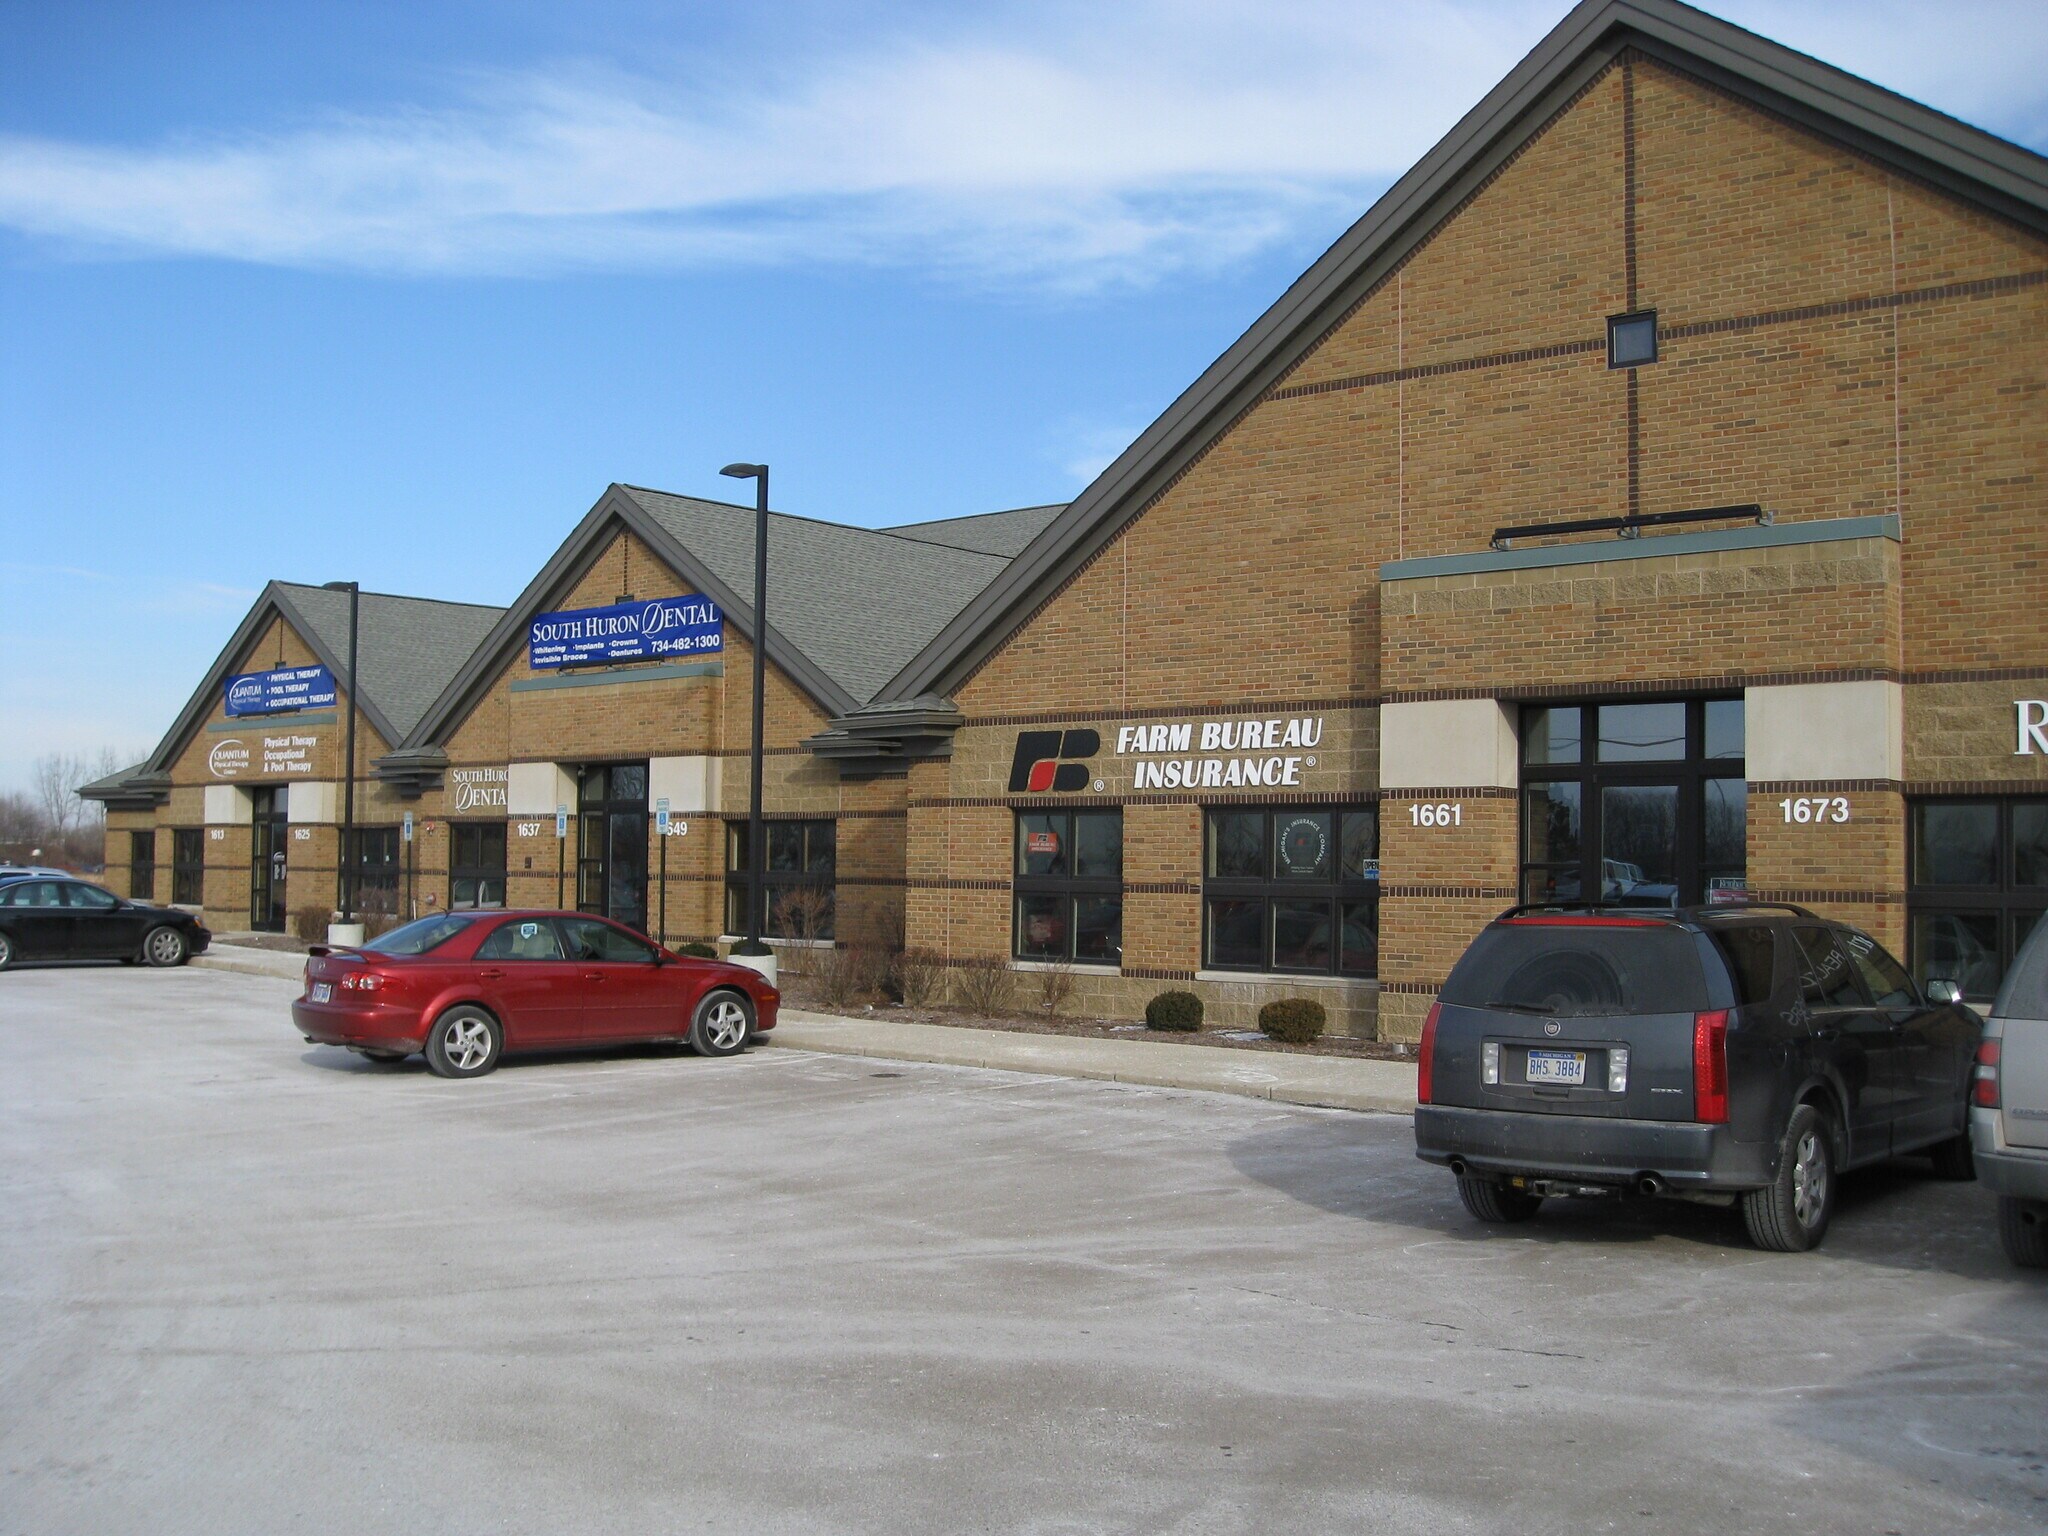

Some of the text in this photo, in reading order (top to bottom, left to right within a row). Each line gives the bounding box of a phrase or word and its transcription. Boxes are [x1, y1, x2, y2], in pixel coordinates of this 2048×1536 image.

[532, 602, 719, 643] SOUTH HURON DENTAL
[611, 639, 638, 647] Crowns
[651, 634, 720, 653] 734-482-1300
[270, 669, 321, 682] PHYSICAL THERAPY
[270, 683, 309, 694] POOL THERAPY
[270, 693, 335, 707] OCCUPATIONAL THERAPY
[264, 736, 317, 748] Physical Therapy
[1117, 718, 1323, 754] FARM BUREAU
[214, 750, 249, 760] QUANTUM
[264, 748, 305, 761] Occupational
[271, 762, 285, 772] Pool
[286, 761, 312, 772] Therapy
[1134, 757, 1302, 789] INSURANCE
[452, 769, 483, 783] SOUTH
[1409, 803, 1461, 827] 1661
[1779, 797, 1849, 823] 1673
[294, 828, 311, 840] 1625
[517, 823, 541, 837] 1637
[1530, 1060, 1581, 1077] BHS 3884
